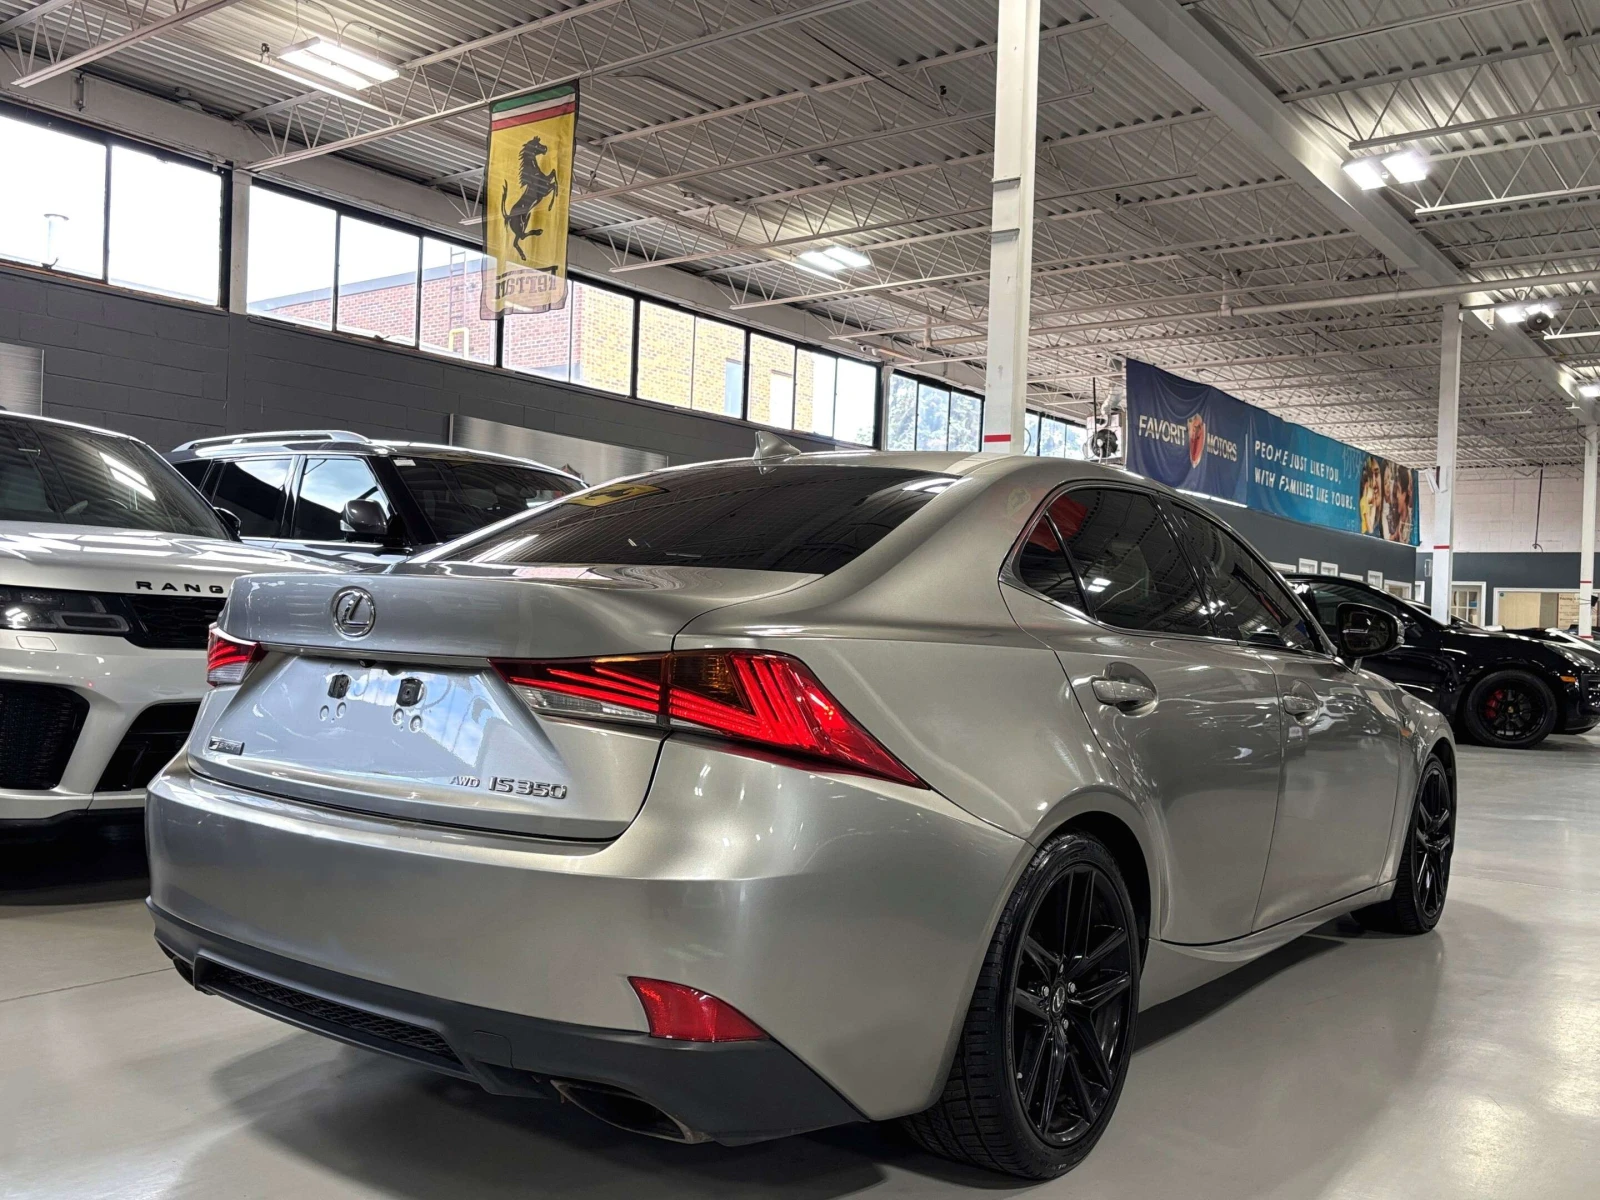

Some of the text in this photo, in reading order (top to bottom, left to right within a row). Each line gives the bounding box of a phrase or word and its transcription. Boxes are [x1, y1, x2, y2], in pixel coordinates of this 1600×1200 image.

[1138, 415, 1237, 461] FAVORIT MOTORS
[1289, 453, 1307, 472] JUST
[1310, 459, 1324, 479] LIKE
[1254, 467, 1356, 510] WITH FAMILIES LIKE YOURS.
[450, 776, 480, 788] AWD
